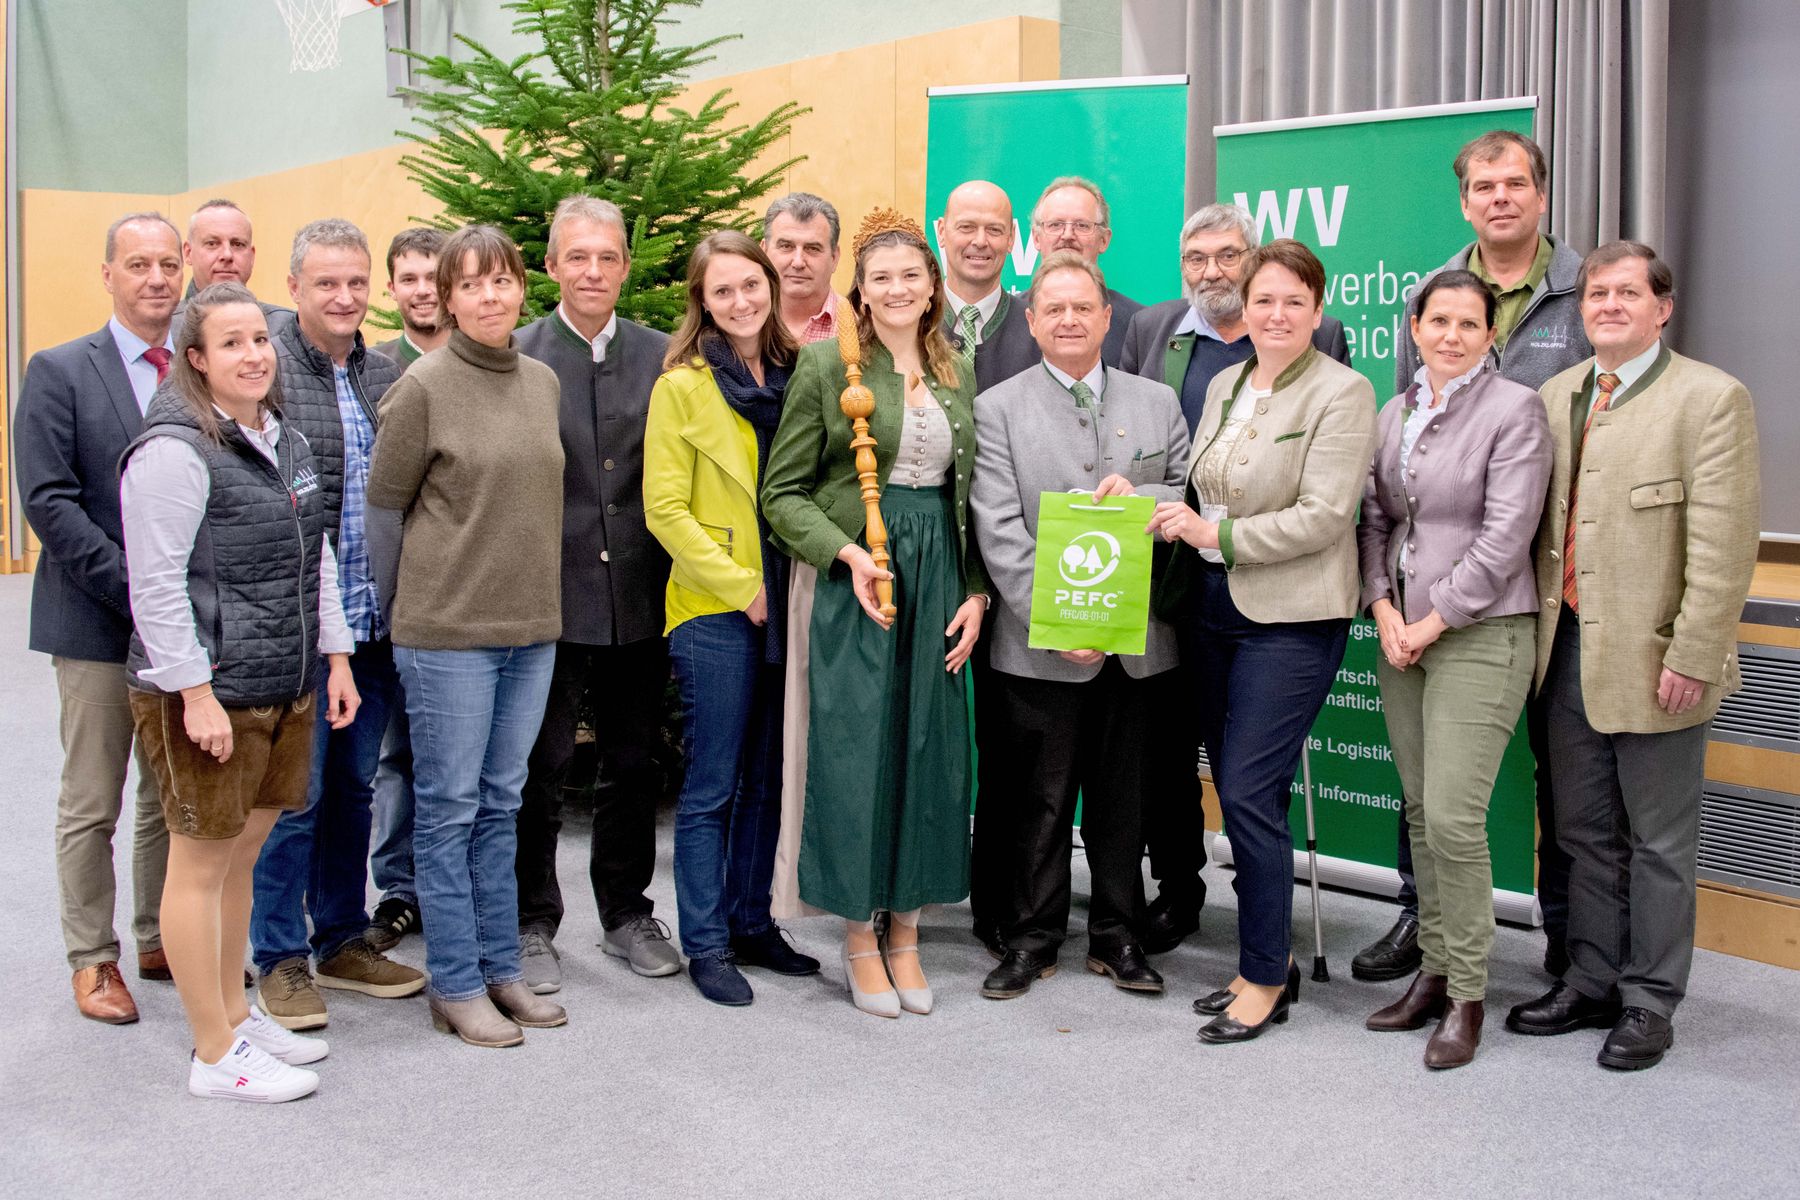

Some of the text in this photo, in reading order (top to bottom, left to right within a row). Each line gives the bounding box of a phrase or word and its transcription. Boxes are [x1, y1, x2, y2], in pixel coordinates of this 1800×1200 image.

[1323, 260, 1431, 306] verba
[1055, 589, 1118, 609] PEFC
[1327, 737, 1393, 762] Logistik
[1319, 782, 1401, 812] Informatio
